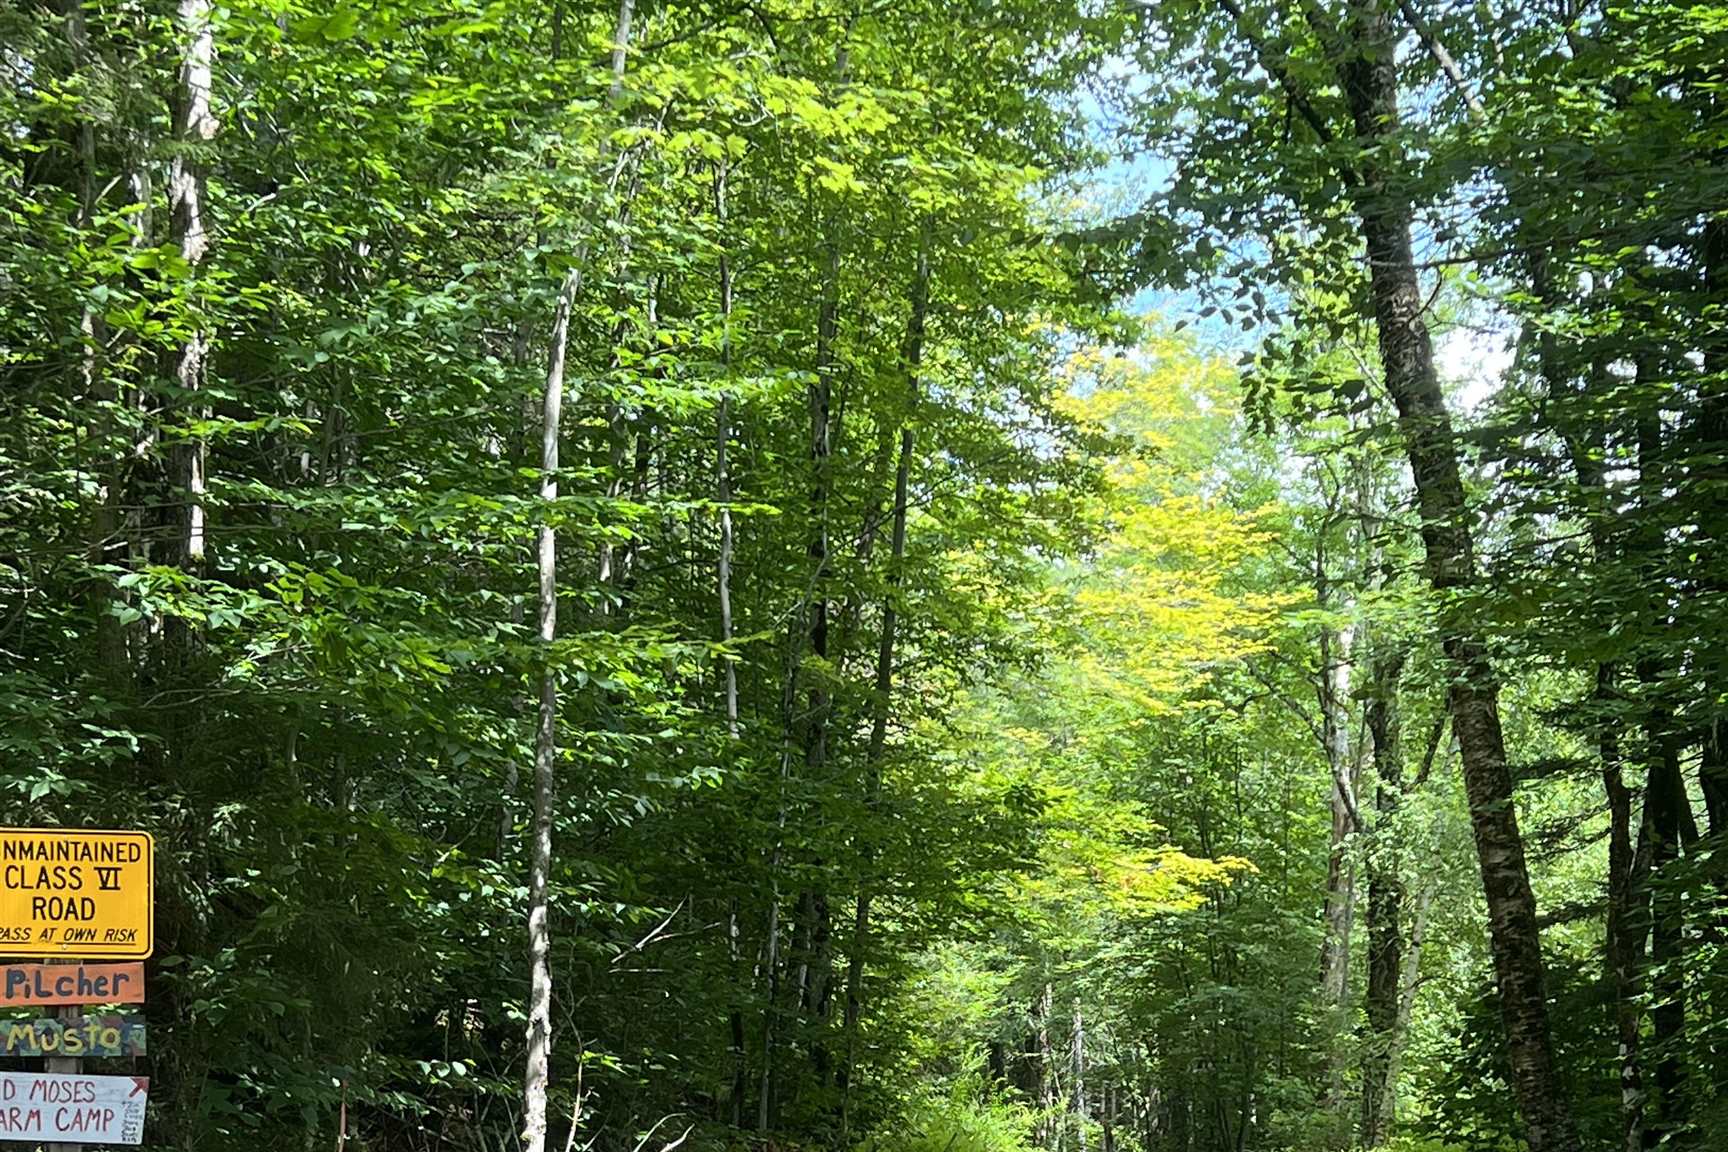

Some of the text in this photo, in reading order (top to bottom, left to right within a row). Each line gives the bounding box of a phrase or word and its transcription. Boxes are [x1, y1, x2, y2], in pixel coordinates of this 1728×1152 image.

[4, 840, 140, 862] NMAINTAINED
[5, 865, 122, 890] CLASS VI
[32, 896, 96, 920] ROAD
[39, 928, 58, 940] AT
[63, 928, 97, 941] OWN
[104, 929, 138, 941] RISK
[29, 1079, 96, 1103] MOSES
[55, 1107, 115, 1132] CAMP
